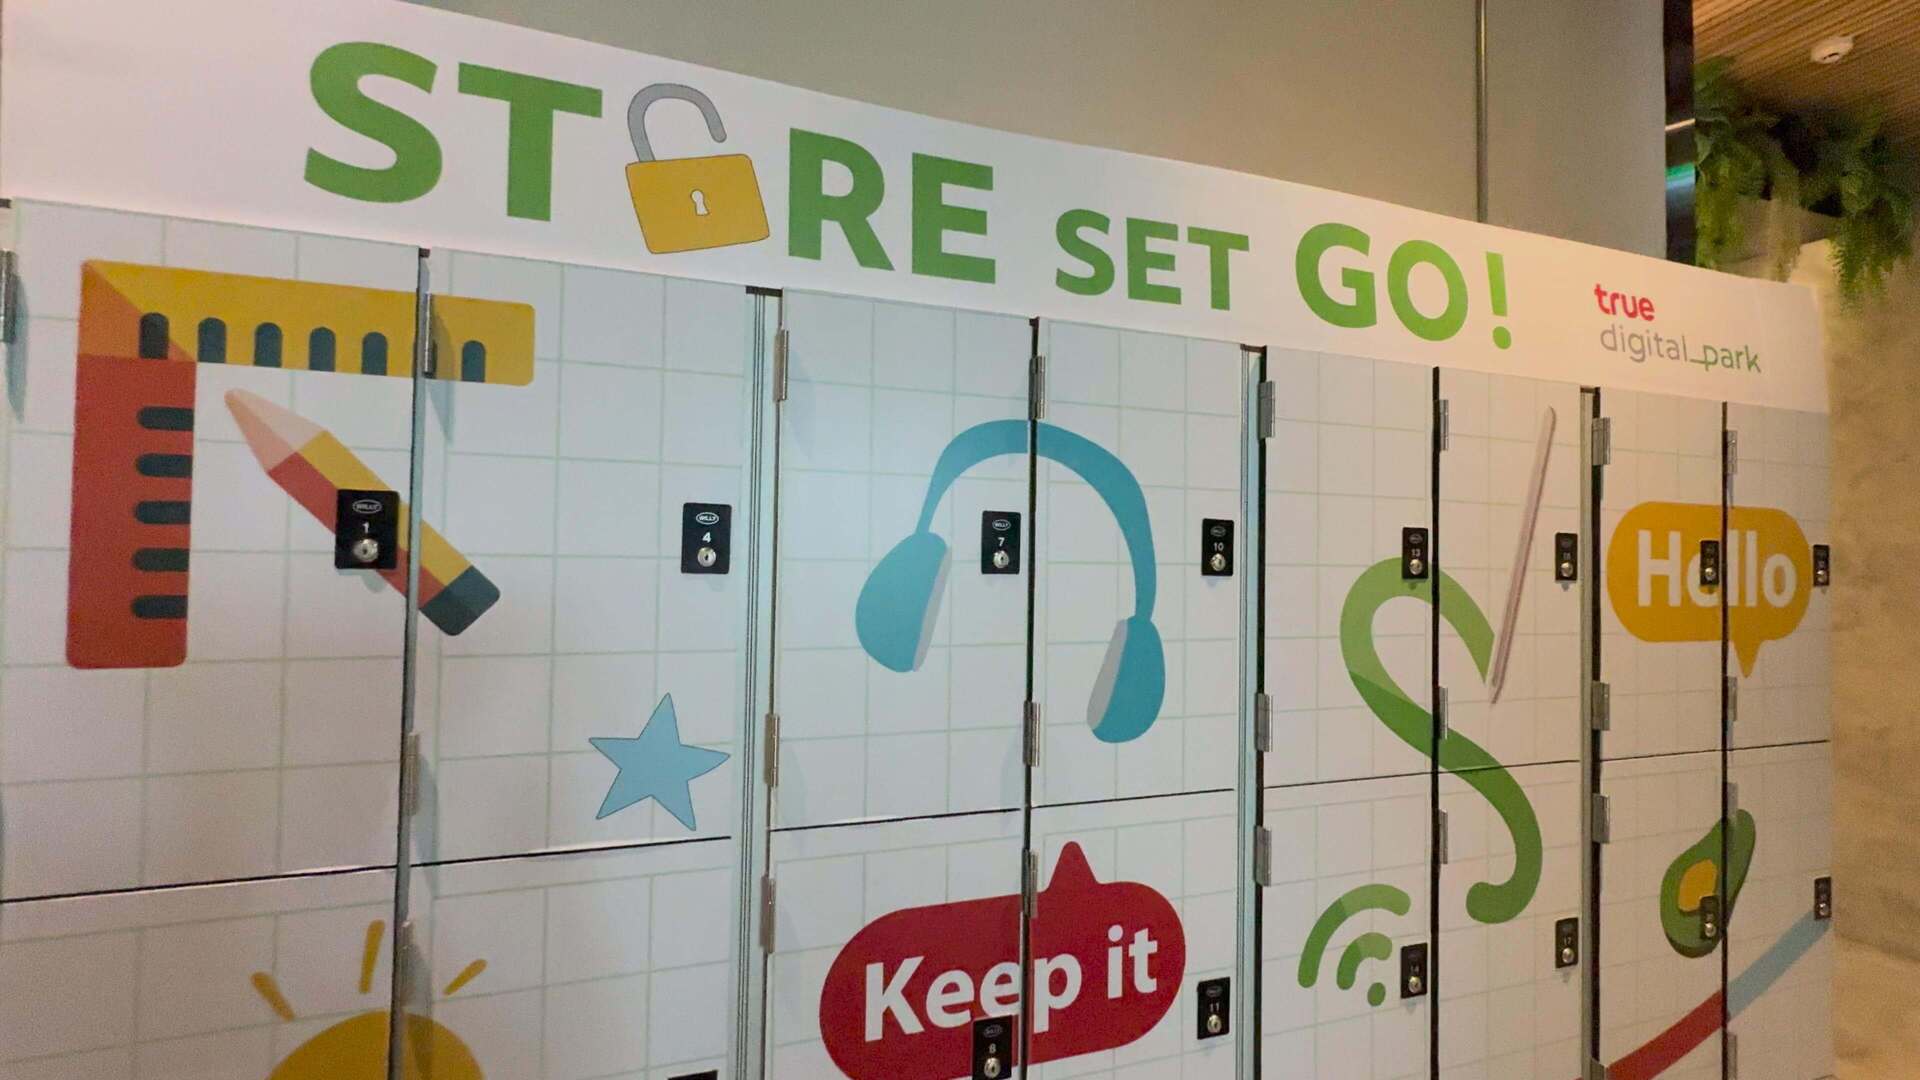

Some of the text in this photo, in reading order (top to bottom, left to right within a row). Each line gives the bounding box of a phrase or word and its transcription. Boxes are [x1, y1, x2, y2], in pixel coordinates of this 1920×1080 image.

[1055, 208, 1250, 311] SET
[1294, 222, 1513, 350] GO!
[1593, 283, 1656, 321] true
[362, 522, 370, 534] 1
[702, 531, 712, 543] 4
[997, 536, 1006, 547] 7
[1213, 541, 1225, 552] 10
[864, 924, 1159, 1043] Keep it
[1210, 1002, 1220, 1013] 11
[988, 1042, 997, 1054] 8
